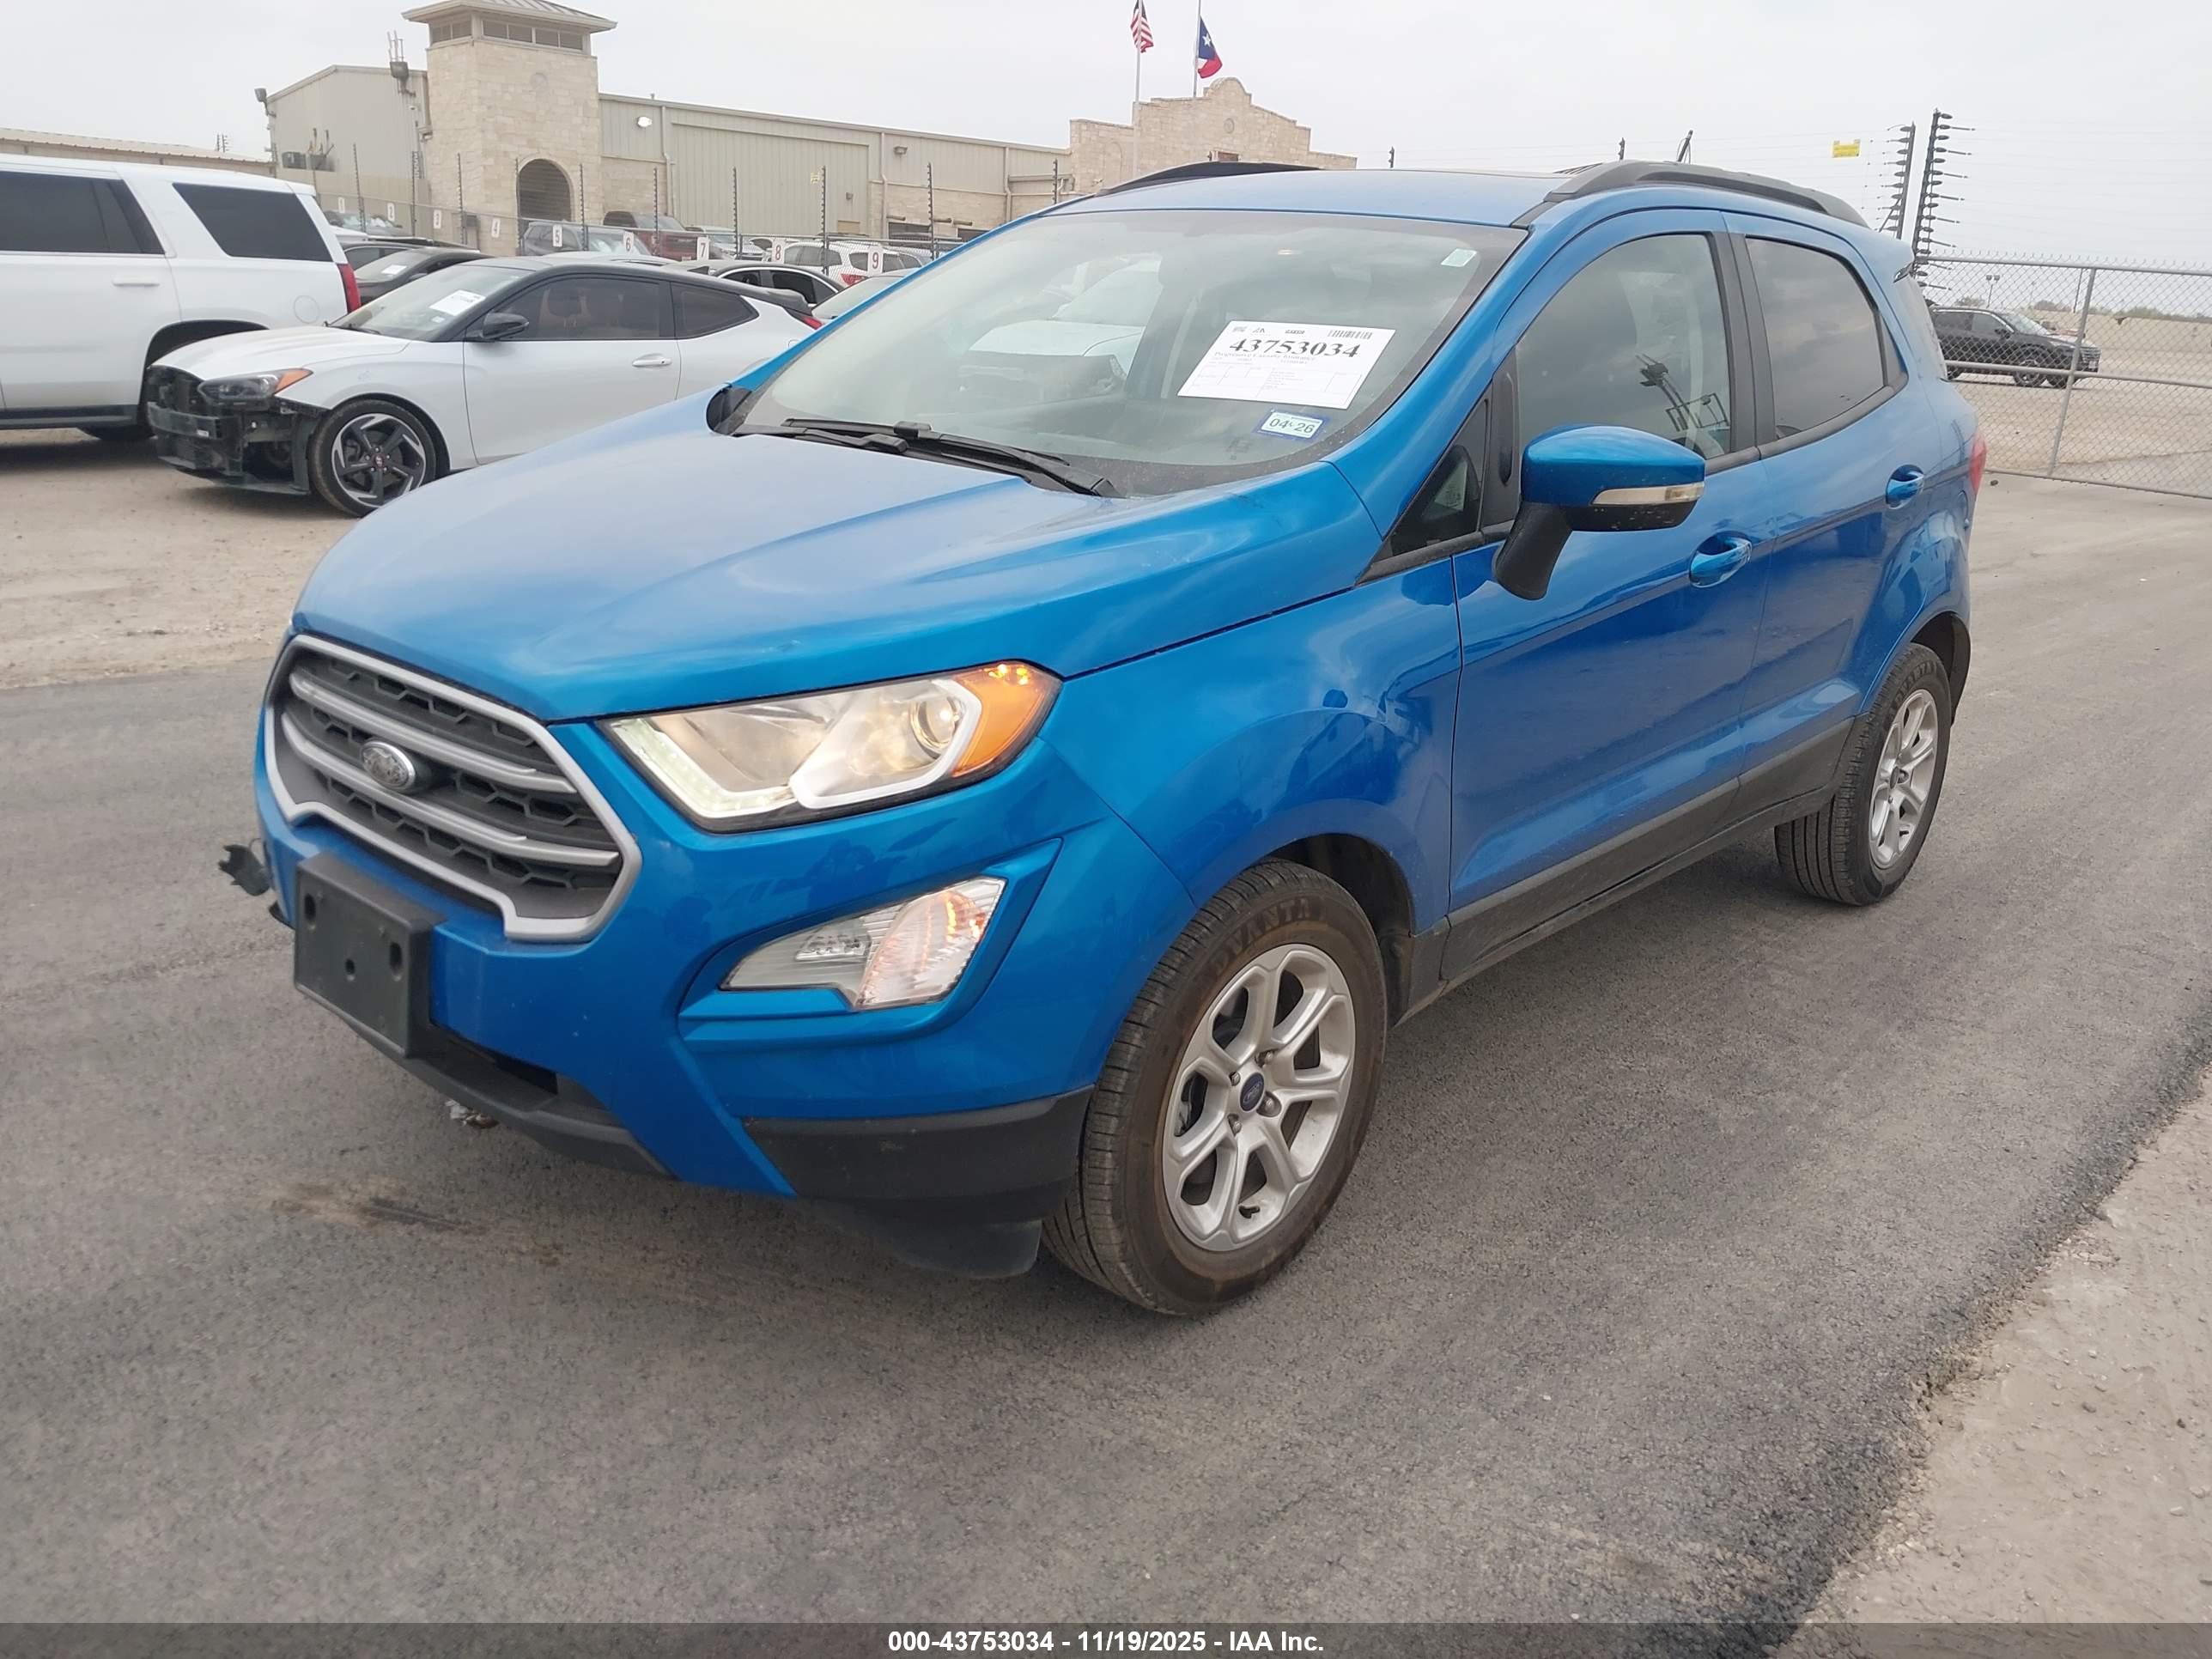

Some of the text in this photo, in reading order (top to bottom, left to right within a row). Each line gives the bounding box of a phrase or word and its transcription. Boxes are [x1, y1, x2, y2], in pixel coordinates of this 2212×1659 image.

[555, 229, 561, 244] 5
[625, 237, 631, 252] 6
[700, 242, 707, 257] 7
[775, 244, 781, 260] 8
[872, 252, 879, 269] 9
[1230, 338, 1361, 358] 43753034
[1269, 418, 1289, 428] 04
[1294, 422, 1315, 434] 26
